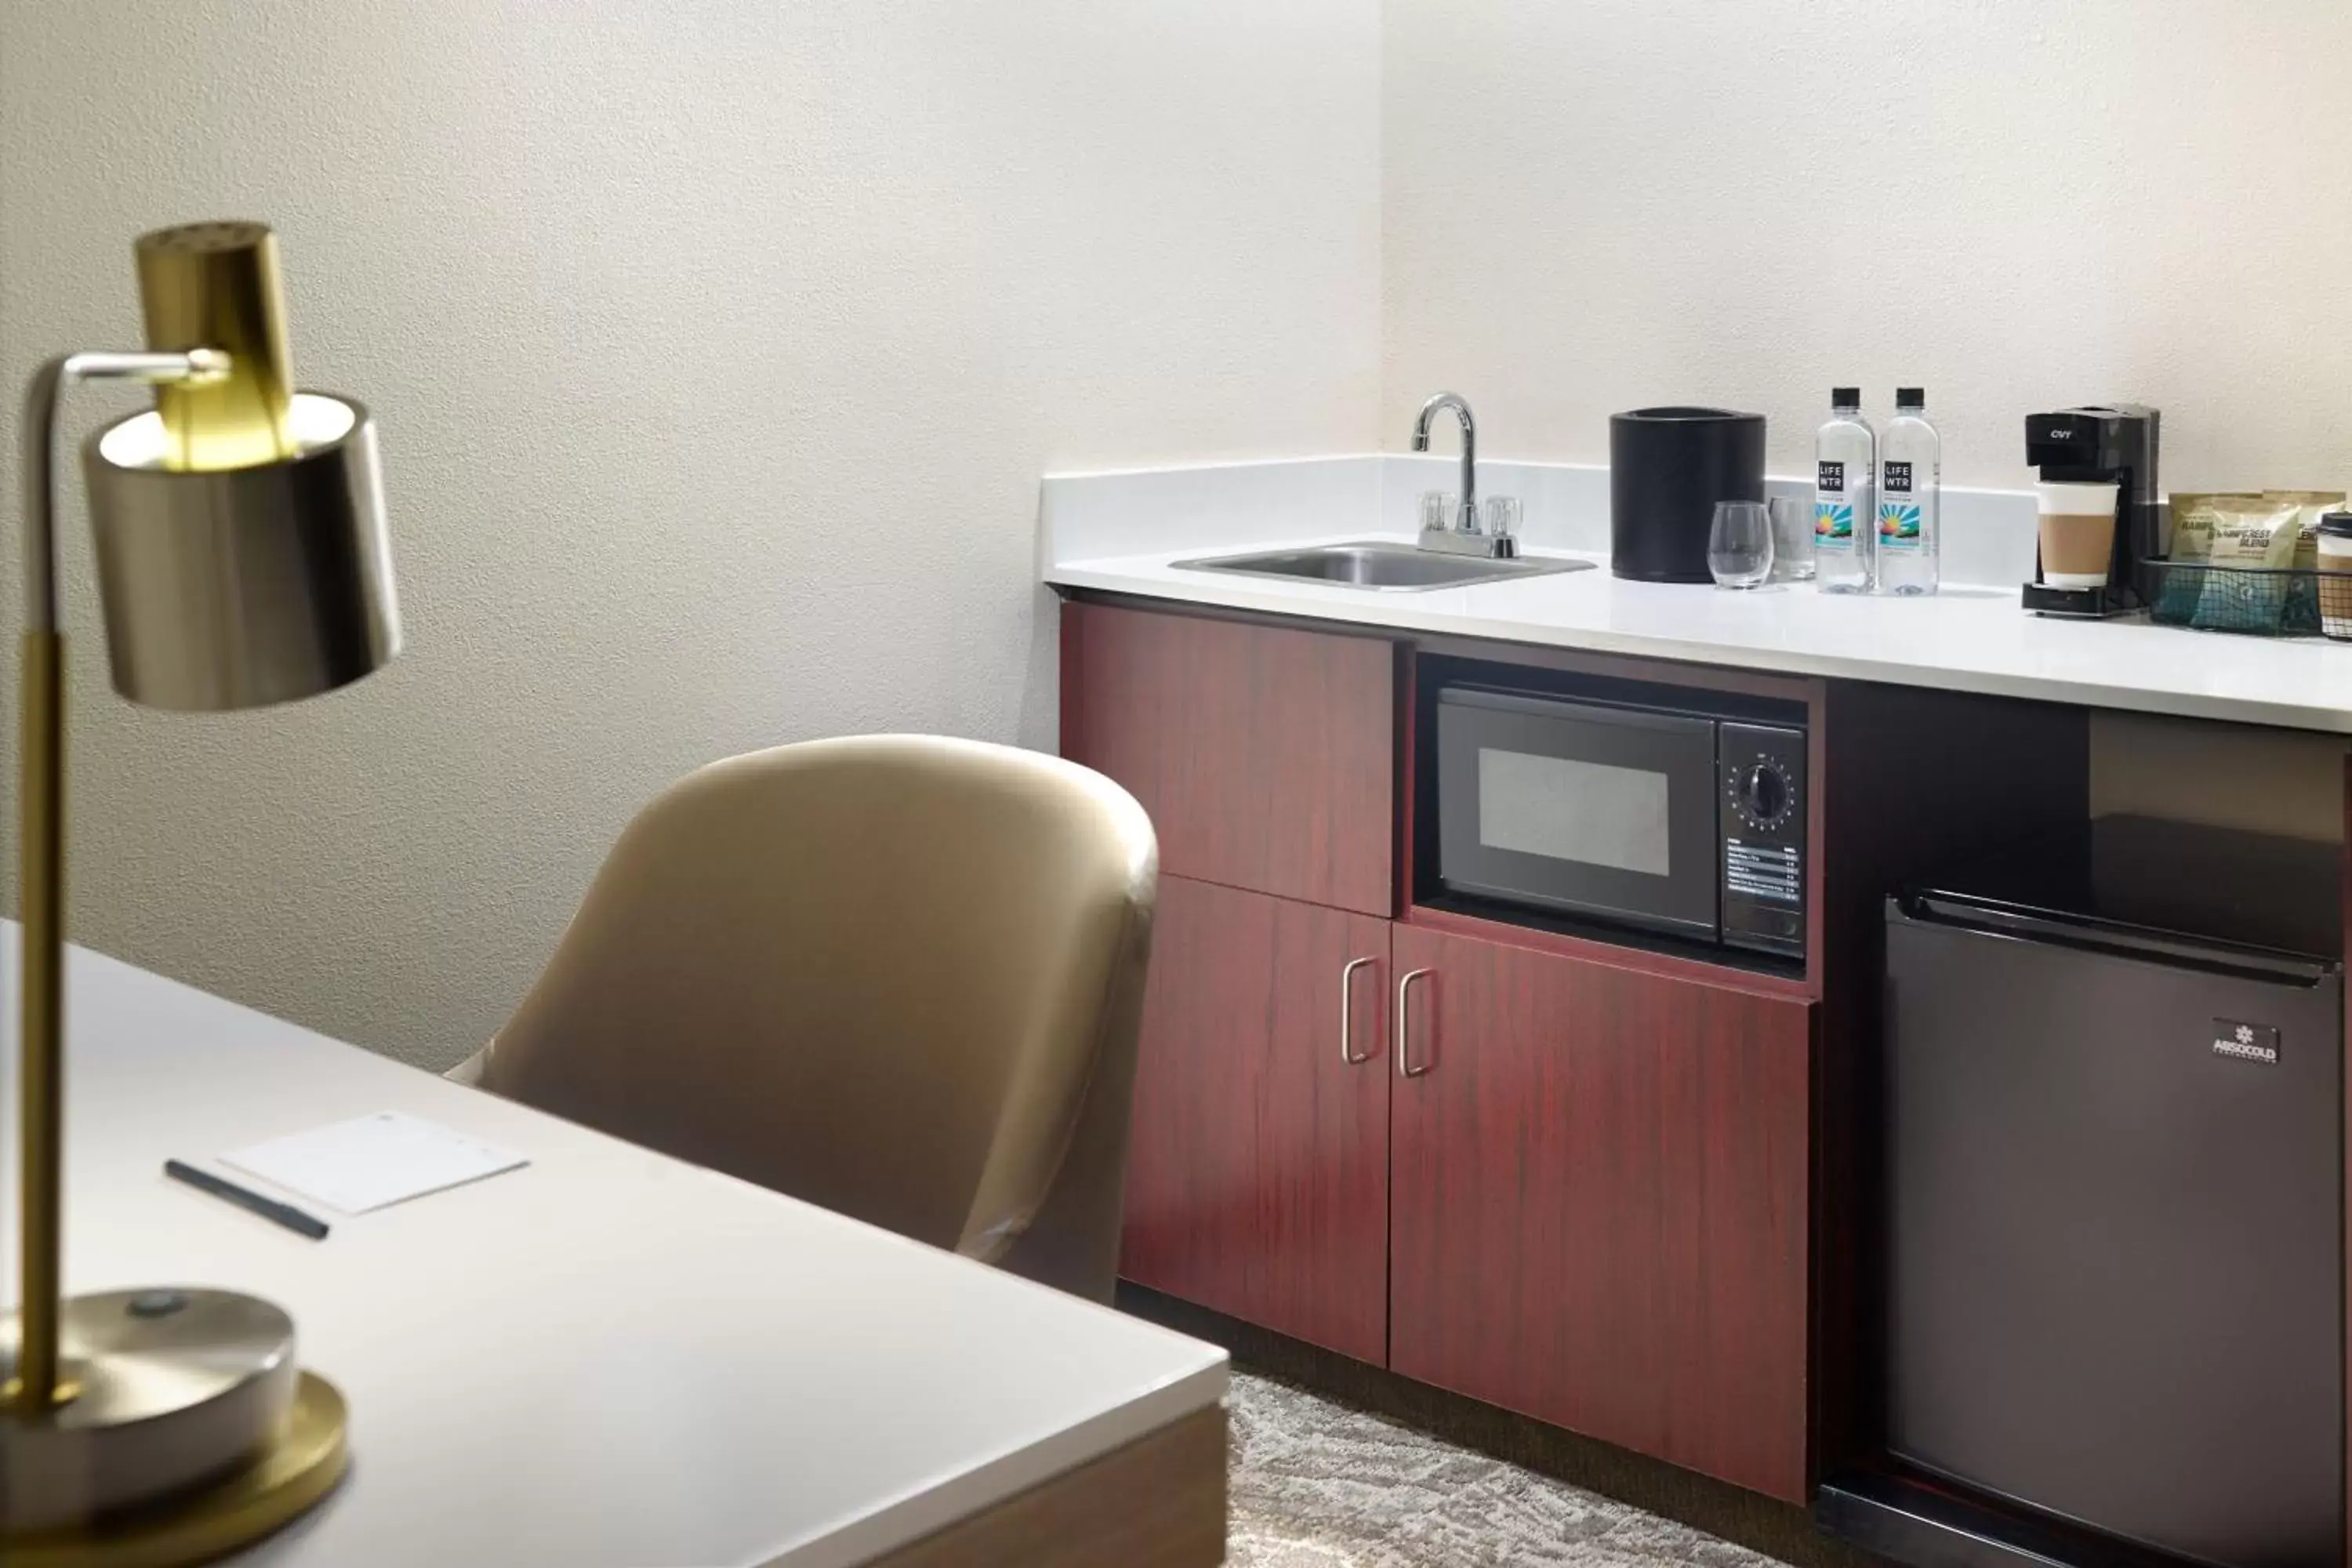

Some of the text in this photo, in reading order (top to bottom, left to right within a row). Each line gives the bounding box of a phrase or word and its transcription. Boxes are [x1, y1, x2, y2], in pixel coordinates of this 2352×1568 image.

[1820, 466, 1842, 476] LIFE
[1886, 466, 1910, 476] LIFE
[1820, 477, 1842, 487] WTR
[1886, 477, 1910, 487] WTR
